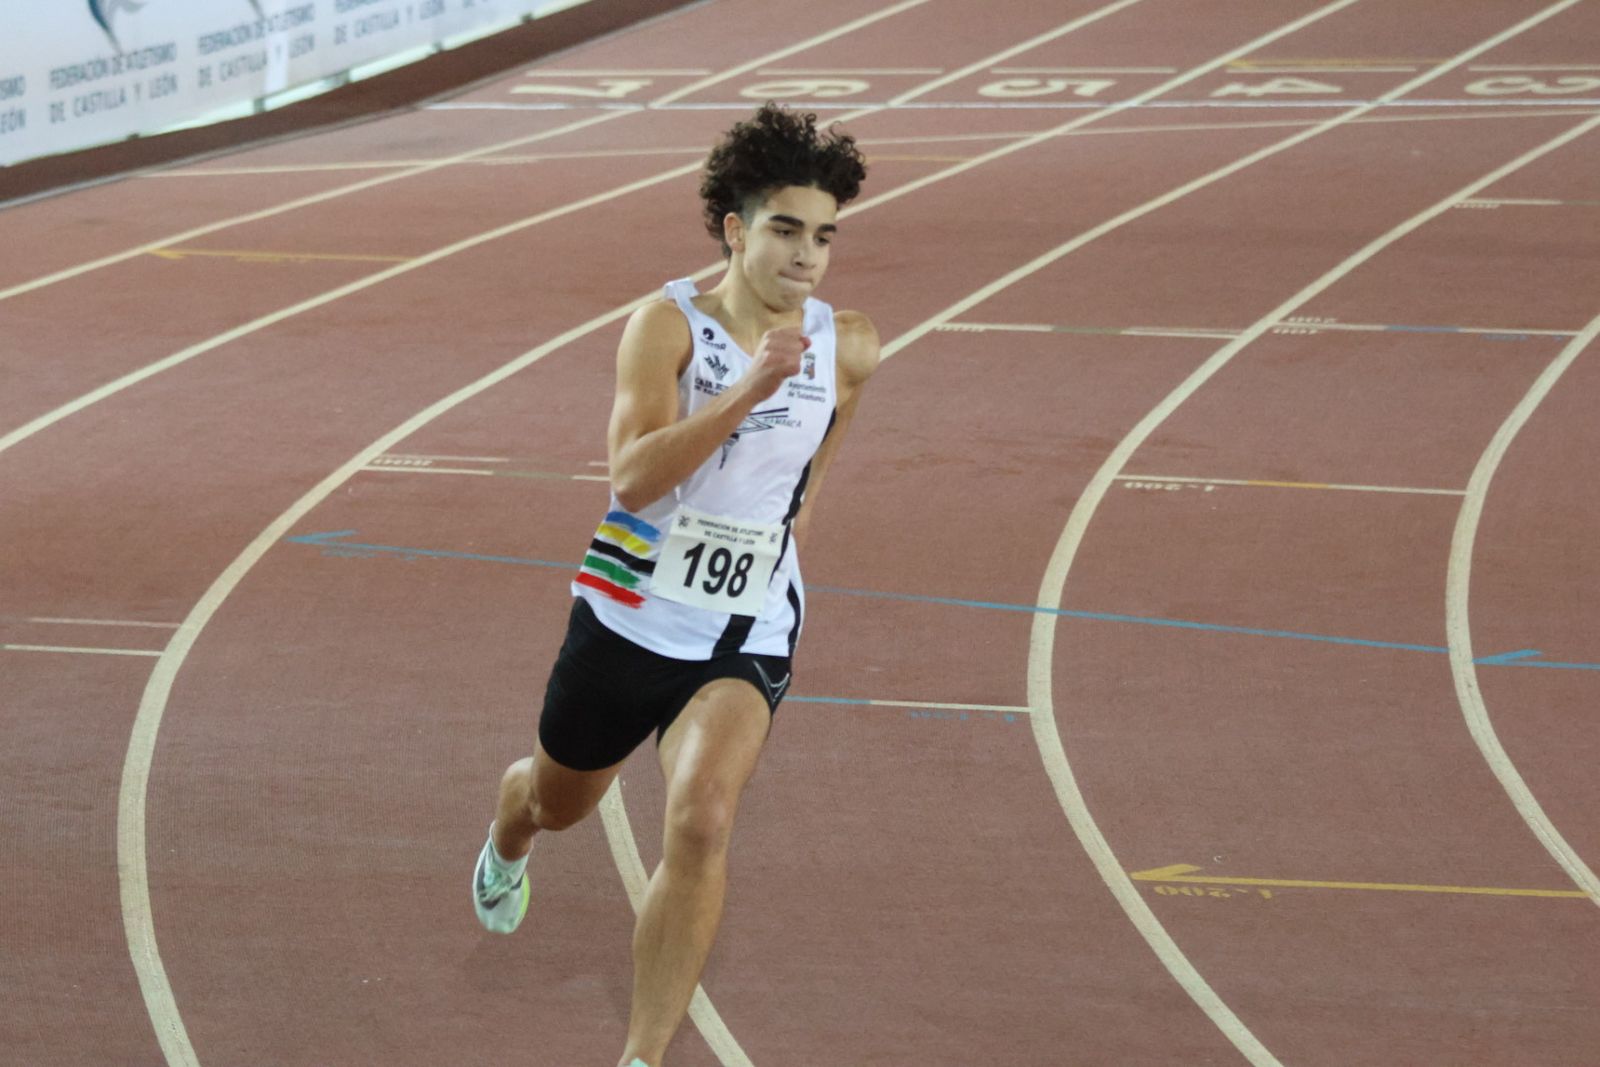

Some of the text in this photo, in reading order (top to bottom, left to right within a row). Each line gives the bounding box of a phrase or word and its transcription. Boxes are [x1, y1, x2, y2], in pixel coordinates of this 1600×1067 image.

[977, 78, 1118, 98] 5
[1208, 76, 1344, 97] 4
[1463, 76, 1600, 96] 3
[50, 101, 65, 124] DE
[73, 86, 126, 118] CASTILLA
[682, 541, 755, 598] 198
